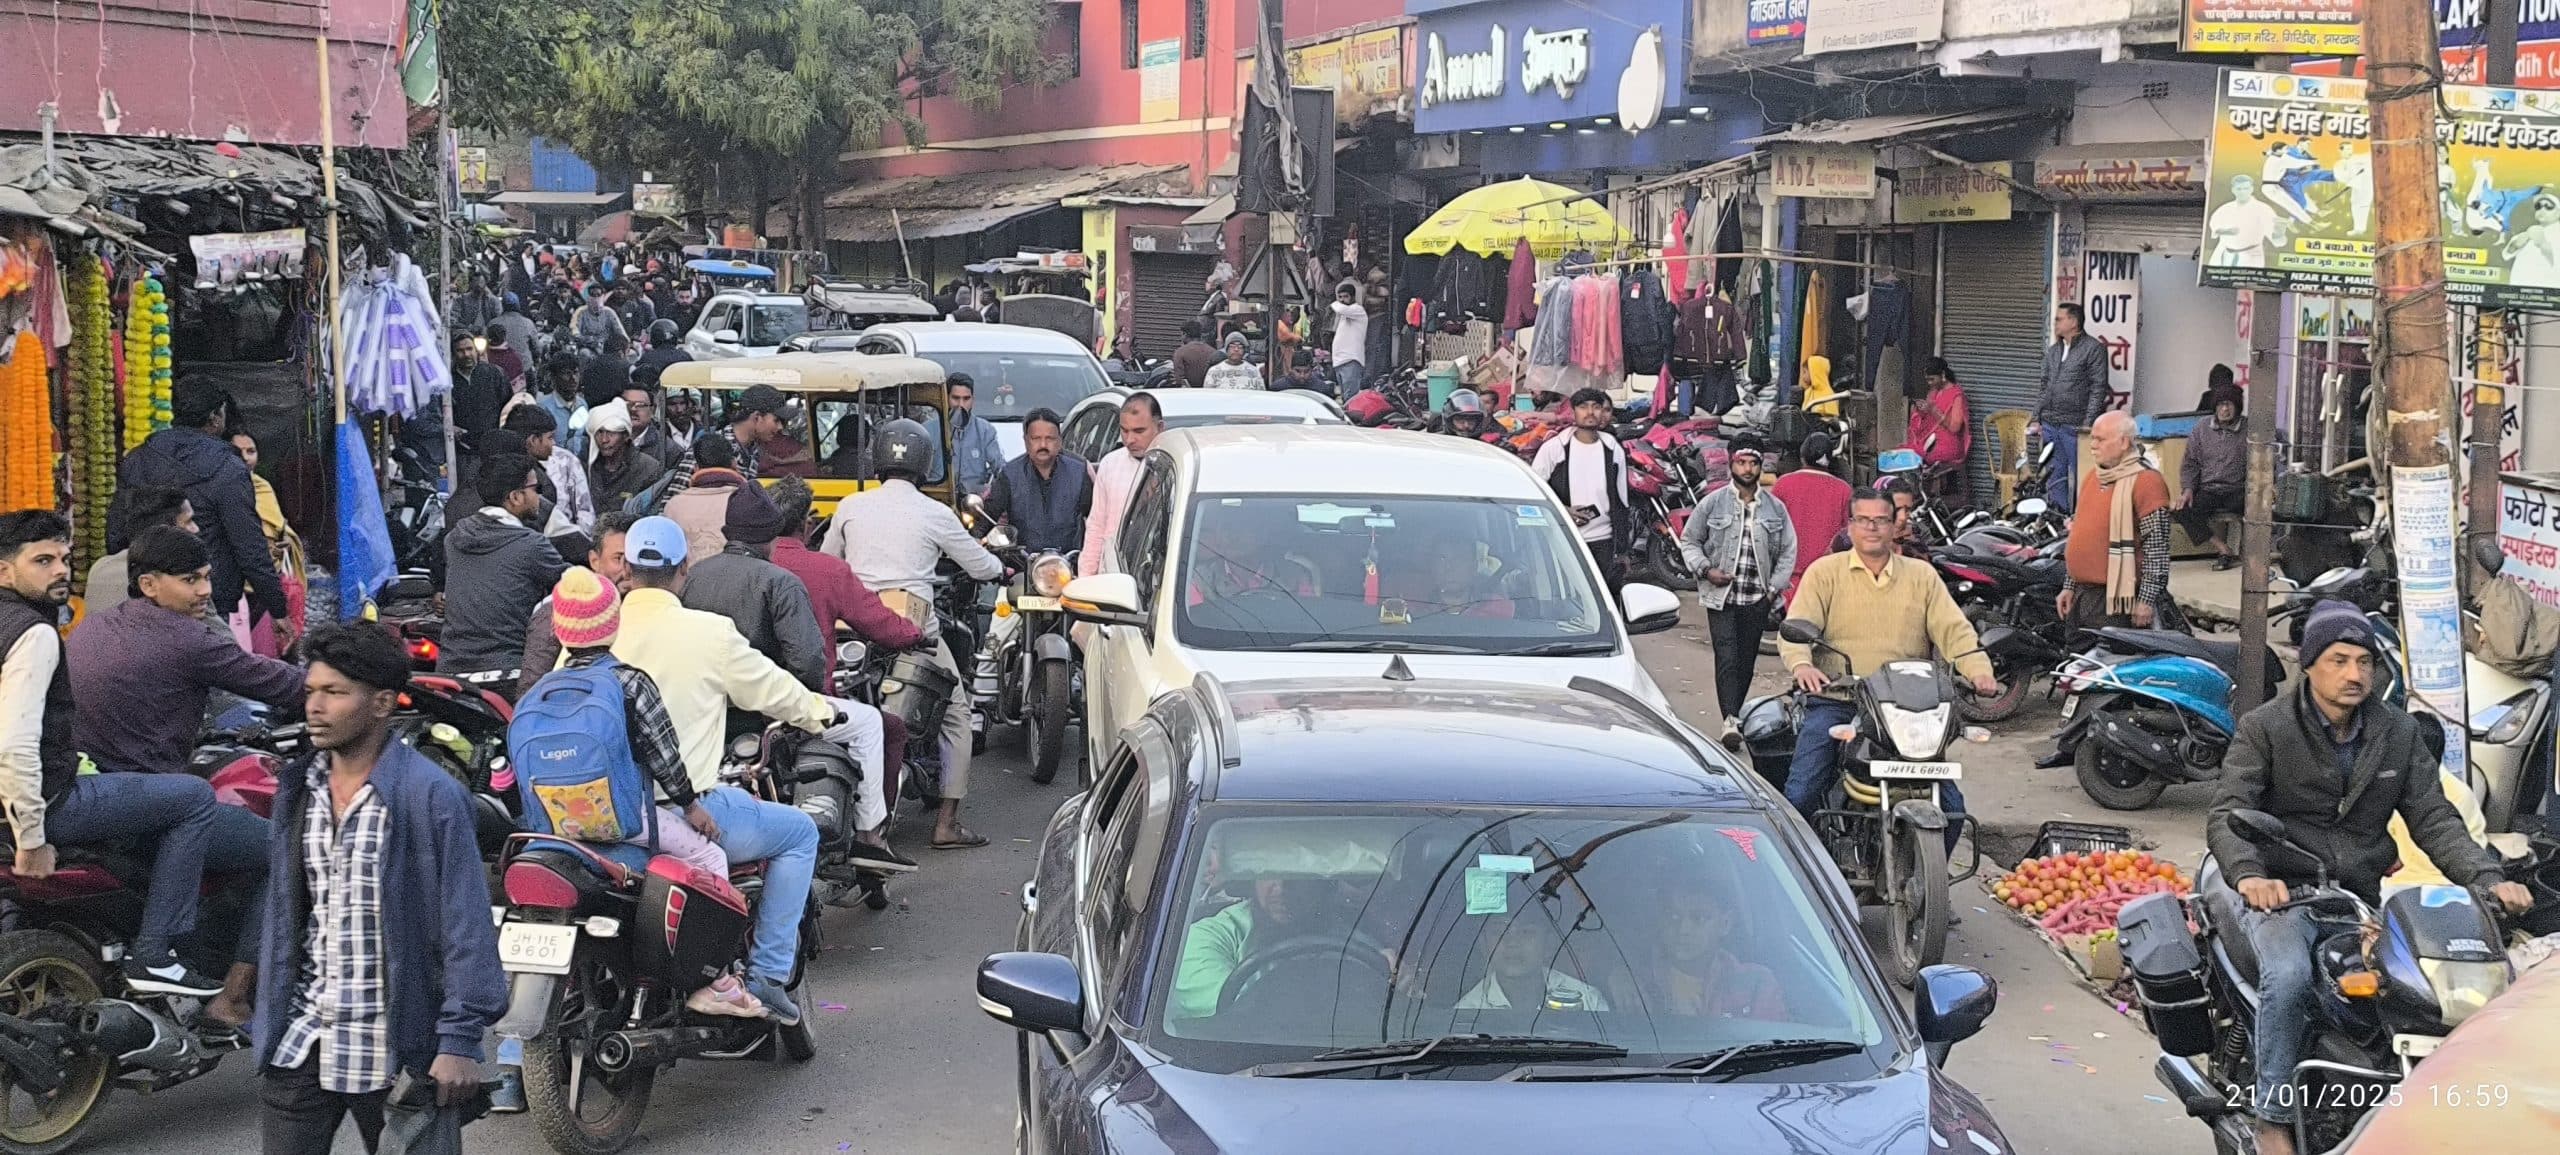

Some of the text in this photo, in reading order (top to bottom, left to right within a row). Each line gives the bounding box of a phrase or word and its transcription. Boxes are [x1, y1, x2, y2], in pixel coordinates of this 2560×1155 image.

[2227, 105, 2279, 137] कपुर
[2279, 101, 2324, 135] सिंह
[2460, 116, 2503, 146] आर्ट
[2088, 251, 2140, 281] PRINT
[2290, 271, 2320, 283] NEAR
[2091, 294, 2132, 323] OUT
[2504, 488, 2548, 528] फोटो
[540, 747, 577, 761] Legon
[510, 943, 558, 960] 9601
